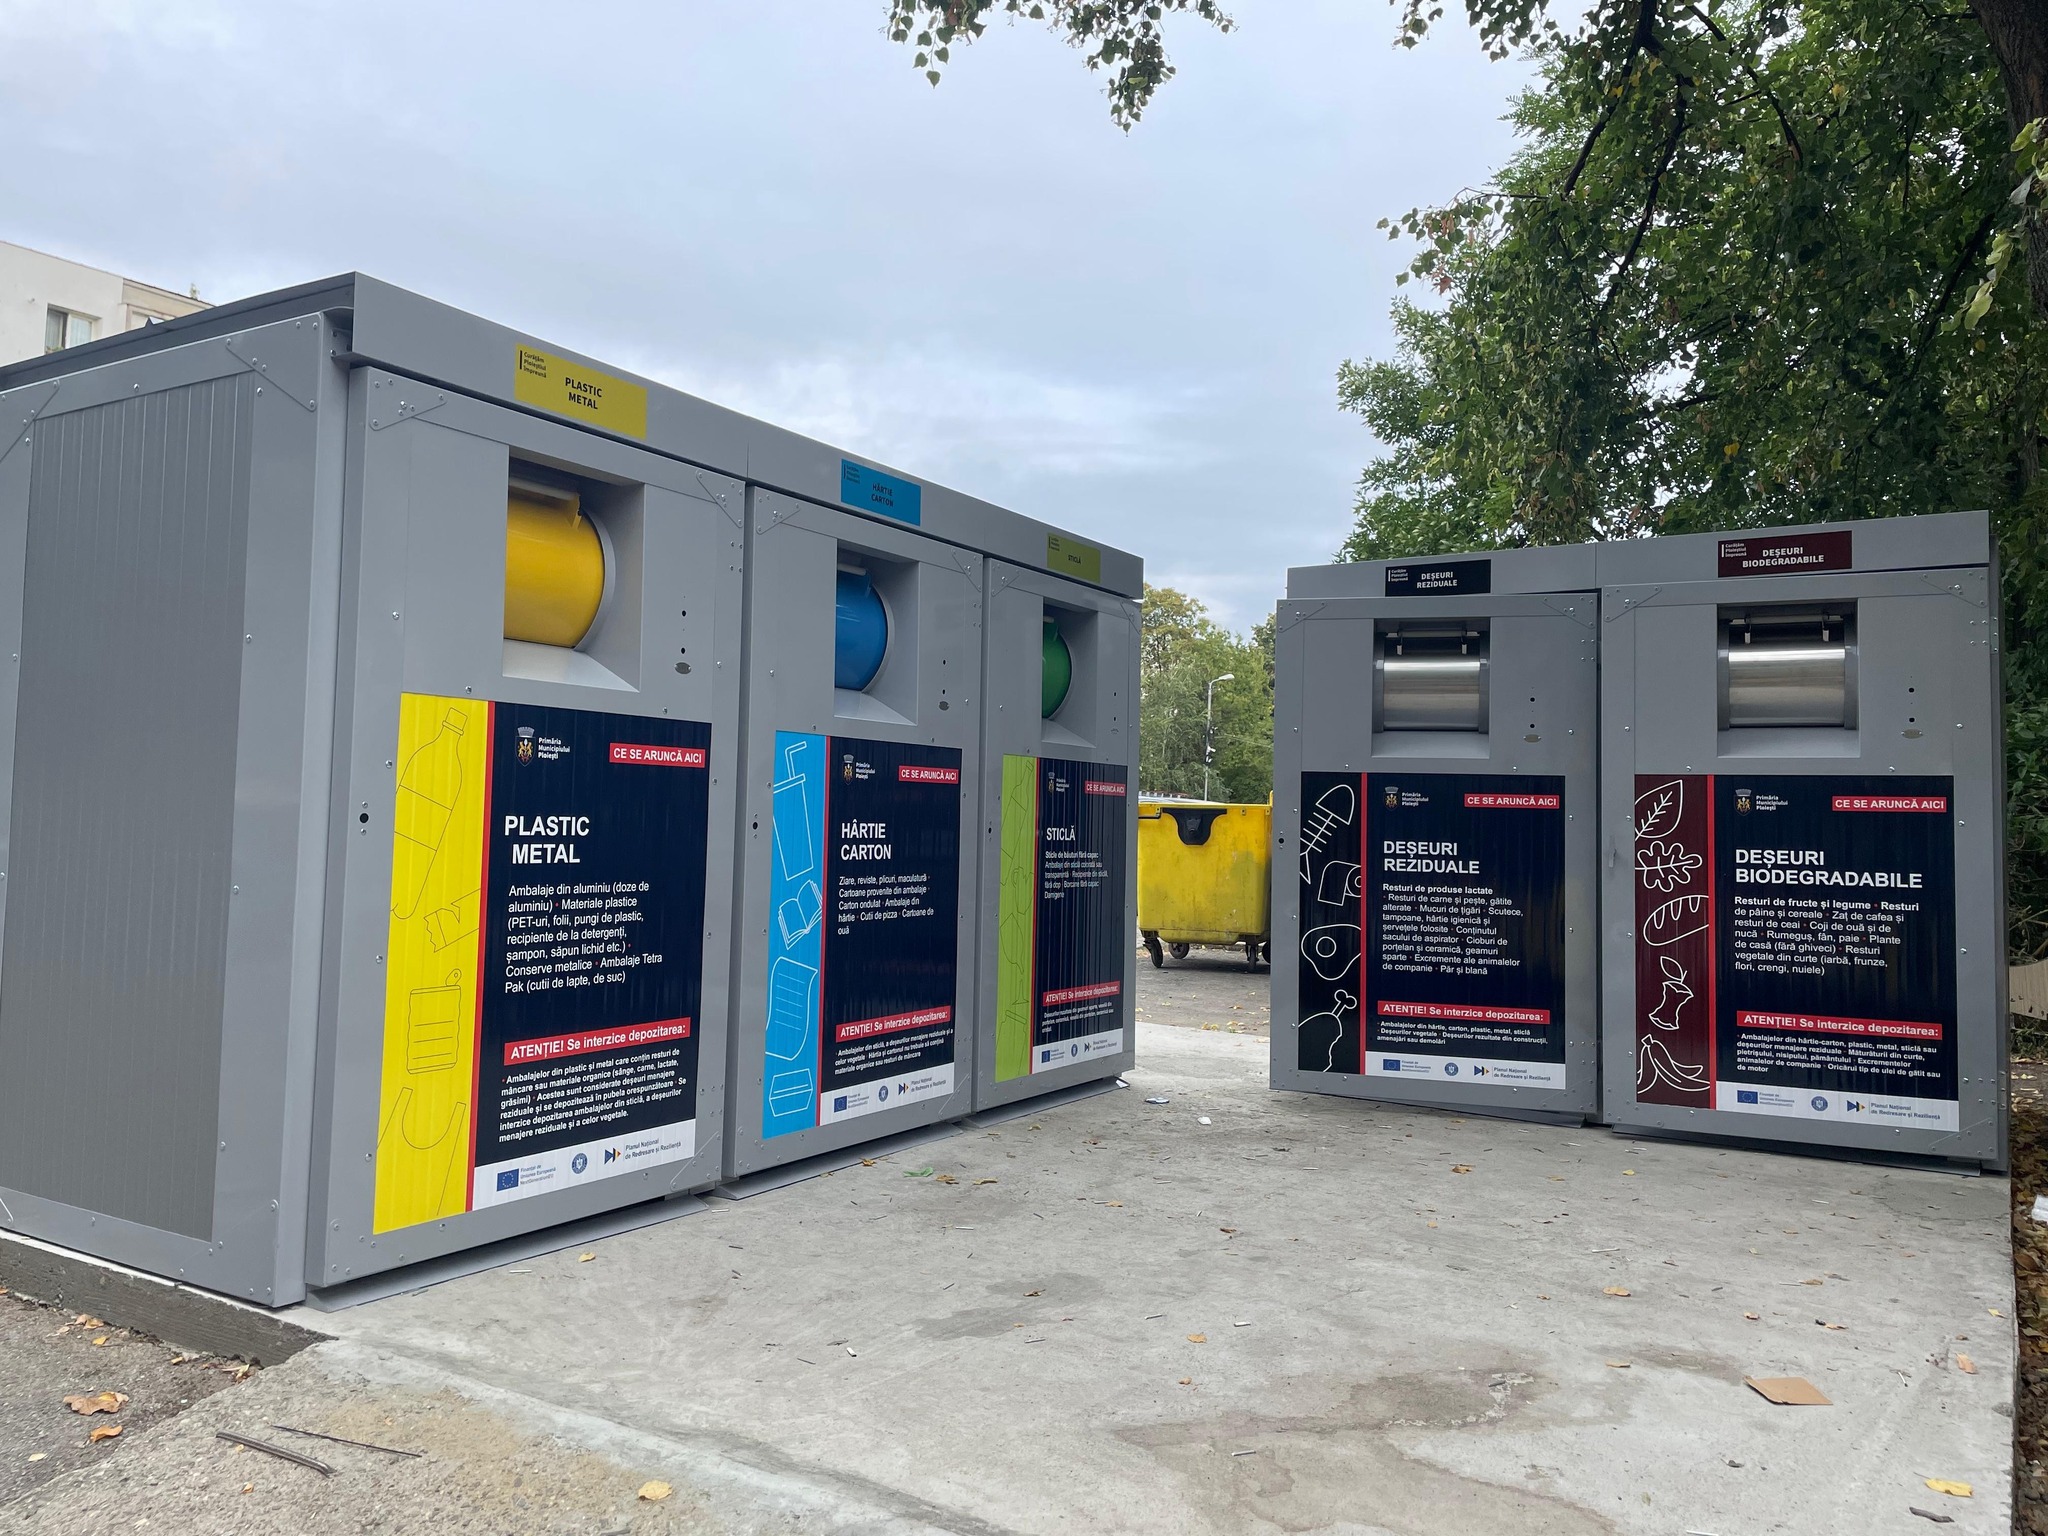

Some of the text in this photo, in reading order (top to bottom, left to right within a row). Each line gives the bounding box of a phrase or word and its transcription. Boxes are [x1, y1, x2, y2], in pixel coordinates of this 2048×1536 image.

[566, 377, 602, 397] PLASTIC
[569, 392, 598, 409] METAL
[873, 483, 892, 496] HÂRTIE
[871, 494, 893, 507] CARTON
[1763, 547, 1803, 558] DEȘEURI
[1743, 555, 1824, 568] BIODEGRADABILE
[1417, 580, 1457, 588] REZIDUALE
[1421, 572, 1453, 581] DEȘEURI
[614, 748, 701, 763] CE SE ARUNCĂ AICI
[901, 770, 956, 780] CE SE ARUNCĂ AICI
[1093, 784, 1099, 792] SE
[1496, 796, 1536, 805] ARUNCĂ
[1537, 798, 1556, 806] AICI
[1835, 799, 1944, 808] CE SE ARUNCĂ AICI
[505, 816, 590, 836] PLASTIC
[842, 819, 886, 838] HÂRTIE
[1046, 826, 1075, 840] STICLĂ
[512, 845, 580, 864] METAL
[840, 845, 891, 860] CARTON
[1383, 841, 1458, 858] DEȘEURI
[1384, 859, 1480, 874] REZIDUALE
[1735, 850, 1824, 868] DEȘEURI
[839, 874, 927, 885] Ziare, reviste, plicuri, maculatură
[1735, 869, 1923, 888] BIODEGRADABILE
[509, 882, 649, 897] Ambalaje din aluminiu (doze de
[1383, 884, 1413, 892] Resturi
[1428, 885, 1462, 894] produse
[1465, 886, 1493, 894] lactate
[508, 897, 637, 912] aluminiu) Materiale plastice
[1388, 894, 1416, 902] Resturi
[1454, 896, 1462, 905] și
[1463, 897, 1488, 905] pește,
[1490, 897, 1512, 906] gătite
[1734, 896, 1919, 911] Resturi de fructe și legume Resturi
[1383, 904, 1412, 912] alterate
[1419, 905, 1447, 913] Mucuri
[1461, 906, 1480, 915] țigări
[1488, 907, 1523, 916] Scutece,
[1734, 907, 1904, 923] de pâine și cereale Zaț de cafea și
[508, 912, 644, 931] (PET-uri, folii, pungi de plastic,
[507, 928, 627, 945] recipiente de la detergenți,
[506, 942, 626, 963] șampon, săpun lichid etc.)
[505, 955, 662, 977] Conserve metalice Ambalaje Tetra
[505, 972, 626, 993] Pak (cutii de lapte, de suc)
[1383, 1004, 1543, 1020] ATENȚIE! Se interzice depozitarea:
[840, 1013, 948, 1037] ATENȚIE! Se interzice depozitarea:
[1381, 1021, 1416, 1029] Ambalajelor
[1428, 1023, 1447, 1031] hârtie,
[1471, 1026, 1492, 1034] plastic,
[1744, 1015, 1939, 1035] ATENȚIE! Se interzice depozitarea:
[510, 1026, 686, 1059] ATENȚIE! Se interzice depozitarea:
[499, 1129, 533, 1142] menajere
[535, 1122, 567, 1135] reziduale
[568, 1120, 574, 1130] și
[582, 1116, 599, 1125] celor
[600, 1110, 628, 1122] vegetale.
